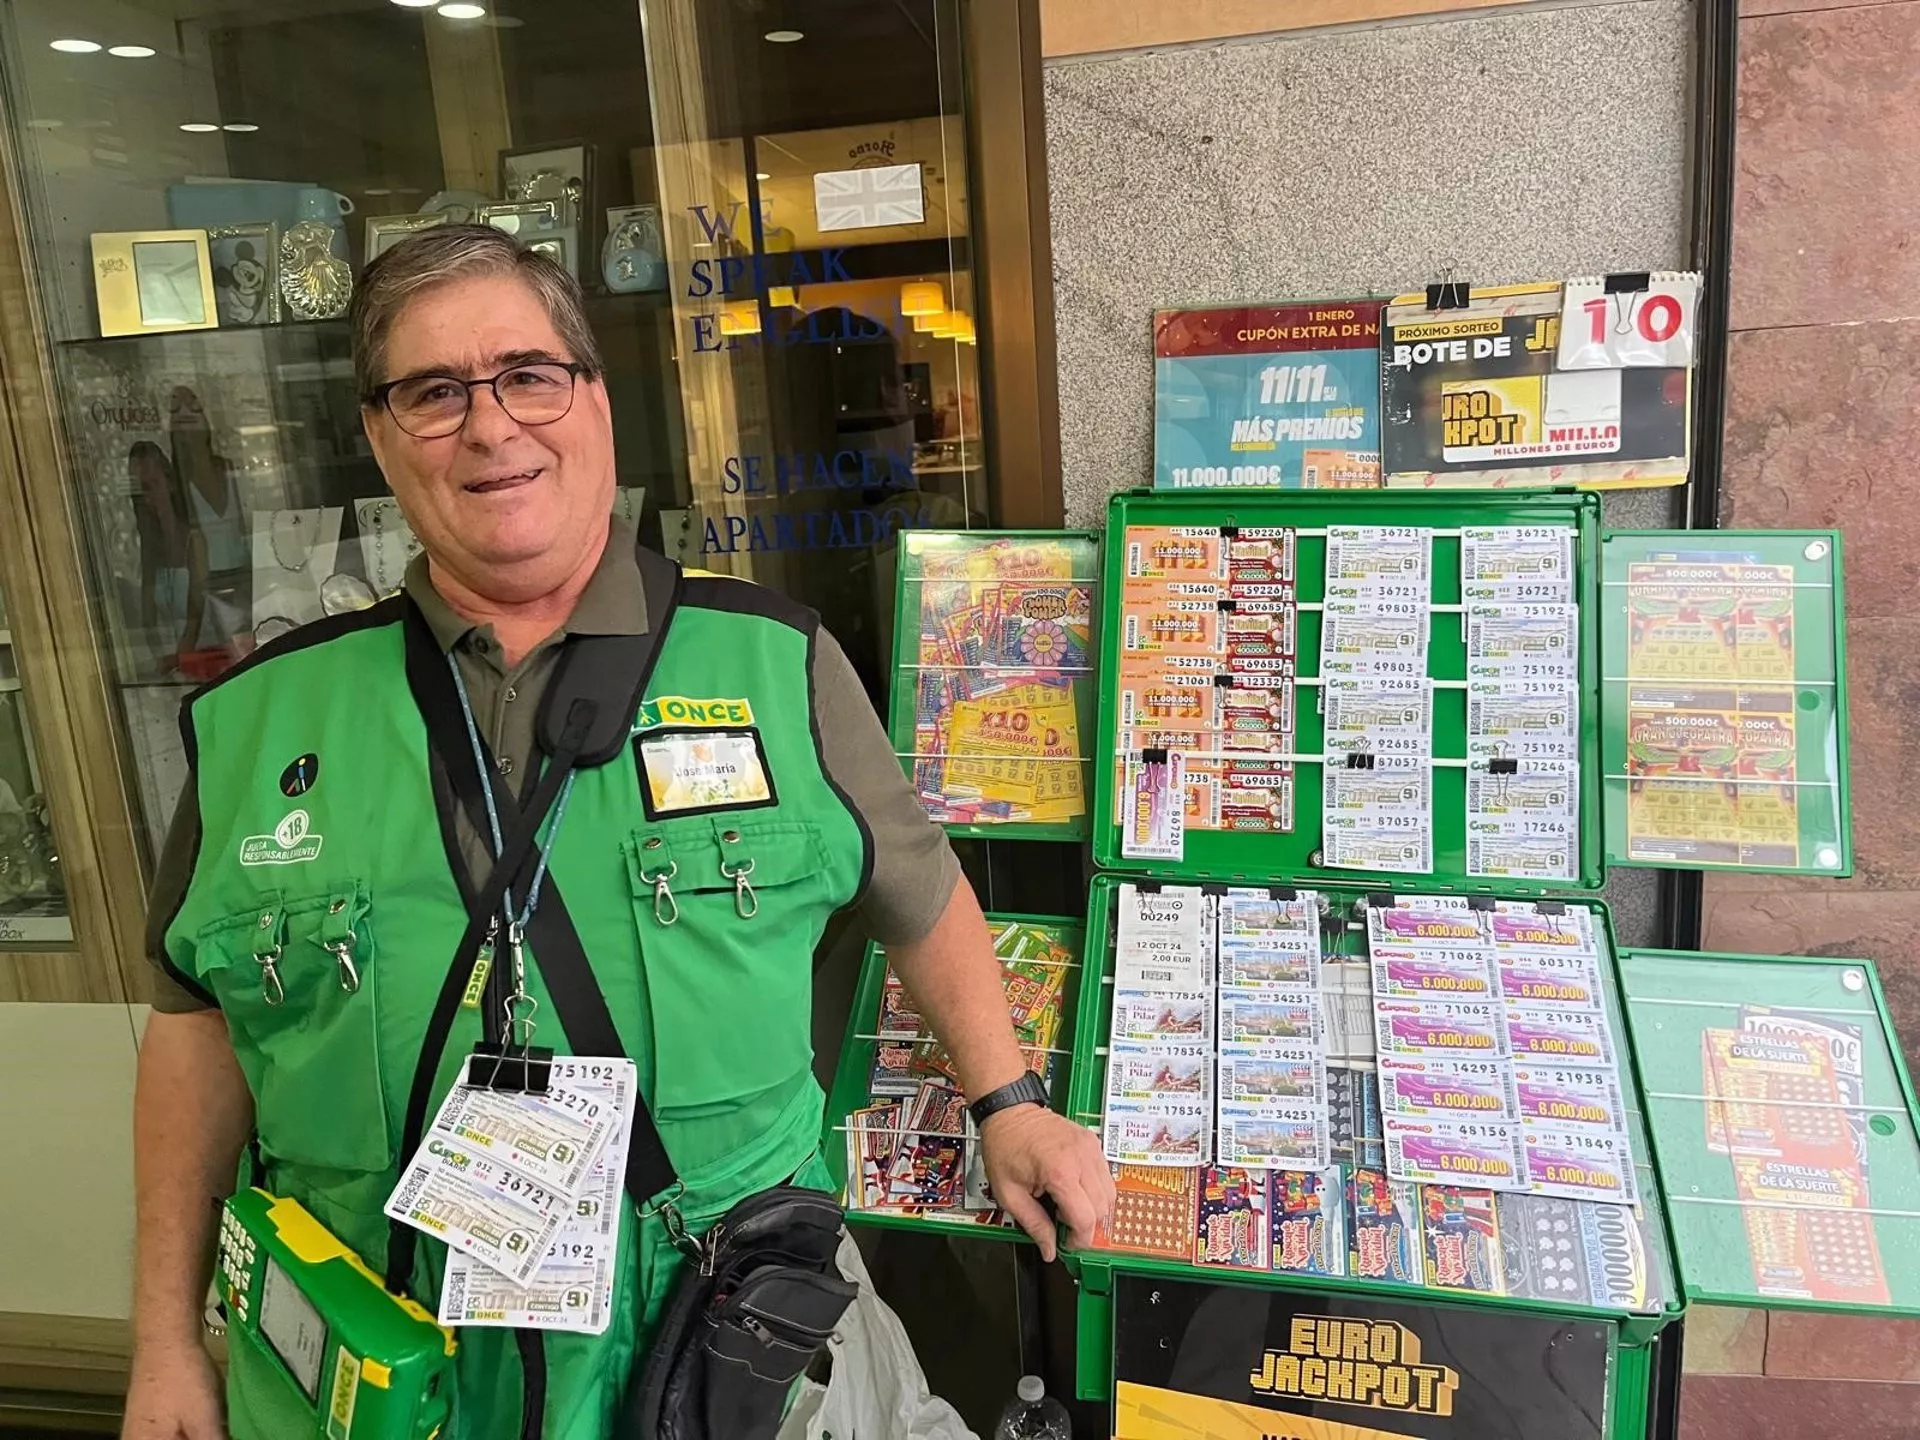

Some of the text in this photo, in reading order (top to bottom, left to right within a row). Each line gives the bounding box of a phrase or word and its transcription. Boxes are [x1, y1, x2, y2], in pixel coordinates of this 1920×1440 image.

[687, 199, 785, 244] WE
[687, 246, 853, 299] SPEAK
[1308, 310, 1355, 322] 1 ENERO
[1584, 294, 1683, 345] 1 0
[691, 293, 931, 353] ENGLISH
[1237, 326, 1289, 342] CUPÓN
[1291, 325, 1337, 339] EXTRA
[1341, 324, 1361, 337] DE
[1399, 321, 1499, 340] PRÓXIMO SORTEO
[1394, 341, 1467, 365] BOTE
[1474, 336, 1512, 359] DE
[1259, 365, 1328, 404] 11/11
[1231, 415, 1364, 443] MÁS PREMIOS
[1493, 441, 1615, 456] MILLONES DE EUROS
[722, 445, 919, 495] SE HACEN
[1172, 465, 1281, 487] 11.000.000€
[1185, 528, 1217, 536] 15640
[1247, 527, 1281, 537] 59226
[1380, 528, 1419, 538] 36721
[1516, 528, 1556, 538] 36721
[1183, 584, 1215, 594] 15640
[1246, 586, 1280, 595] 59226
[1378, 586, 1417, 596] 36721
[1516, 586, 1557, 596] 36721
[1180, 601, 1214, 611] 52738
[1247, 602, 1282, 611] 69685
[1377, 604, 1416, 615] 49803
[1523, 606, 1565, 616] 75192
[1178, 658, 1213, 668] 52738
[1246, 659, 1281, 669] 69685
[1373, 662, 1413, 673] 49803
[1523, 665, 1564, 675] 75192
[1176, 676, 1211, 685] 21061
[1246, 677, 1280, 687] 12332
[1380, 679, 1420, 689] 92685
[1523, 682, 1564, 692] 75192
[666, 701, 745, 722] ONCE
[1378, 738, 1417, 749] 92685
[1523, 743, 1564, 753] 75192
[1378, 757, 1418, 768] 87057
[1525, 762, 1564, 772] 17246
[1244, 775, 1280, 786] 69685
[1378, 816, 1418, 827] 87057
[1524, 822, 1564, 833] 17246
[282, 817, 302, 840] +18
[1170, 811, 1181, 846] 86720
[243, 847, 317, 860] RESPONSABLEMENTE
[1433, 899, 1467, 909] 7106
[1416, 925, 1477, 937] 6.000.000
[1136, 942, 1182, 950] 12 OCT 24
[1272, 941, 1309, 950] 34251
[1152, 955, 1192, 964] 2,00 EUR
[1440, 951, 1483, 961] 71062
[1539, 957, 1584, 969] 60317
[466, 962, 486, 1001] ONCE
[1422, 977, 1484, 992] 6.000.000
[1273, 993, 1311, 1004] 34251
[1522, 984, 1584, 1001] 6.000.000
[1445, 1004, 1490, 1016] 71062
[1546, 1012, 1592, 1024] 21938
[1428, 1033, 1490, 1049] 6.000.000
[1529, 1038, 1595, 1054] 6.000.000
[1166, 1047, 1203, 1056] 17834
[1274, 1049, 1313, 1060] 34251
[554, 1064, 613, 1080] 75192
[1129, 1068, 1153, 1078] Pilar
[1451, 1063, 1497, 1074] 14293
[1555, 1071, 1604, 1085] 21938
[545, 1085, 599, 1119] 23270
[1433, 1092, 1498, 1110] 6.000.000
[1165, 1105, 1203, 1116] 17834
[1276, 1109, 1316, 1121] 34251
[1538, 1101, 1605, 1121] 6.000.000
[1126, 1129, 1150, 1138] Pilar
[1459, 1125, 1507, 1137] 48156
[465, 1130, 493, 1146] ONCE
[1565, 1135, 1613, 1151] 31849
[441, 1157, 466, 1173] DIARIO
[1440, 1154, 1507, 1174] 6.000.000
[1765, 1162, 1830, 1178] ESTRELLAS
[1546, 1166, 1615, 1188] 6.000.000
[1760, 1175, 1842, 1194] DE LA SUERTE
[498, 1171, 555, 1211] 36721
[419, 1215, 446, 1231] ONCE
[476, 1311, 505, 1320] ONCE
[1290, 1317, 1398, 1363] EURO
[1250, 1353, 1439, 1409] JACKPOT
[335, 1358, 355, 1419] ONCE
